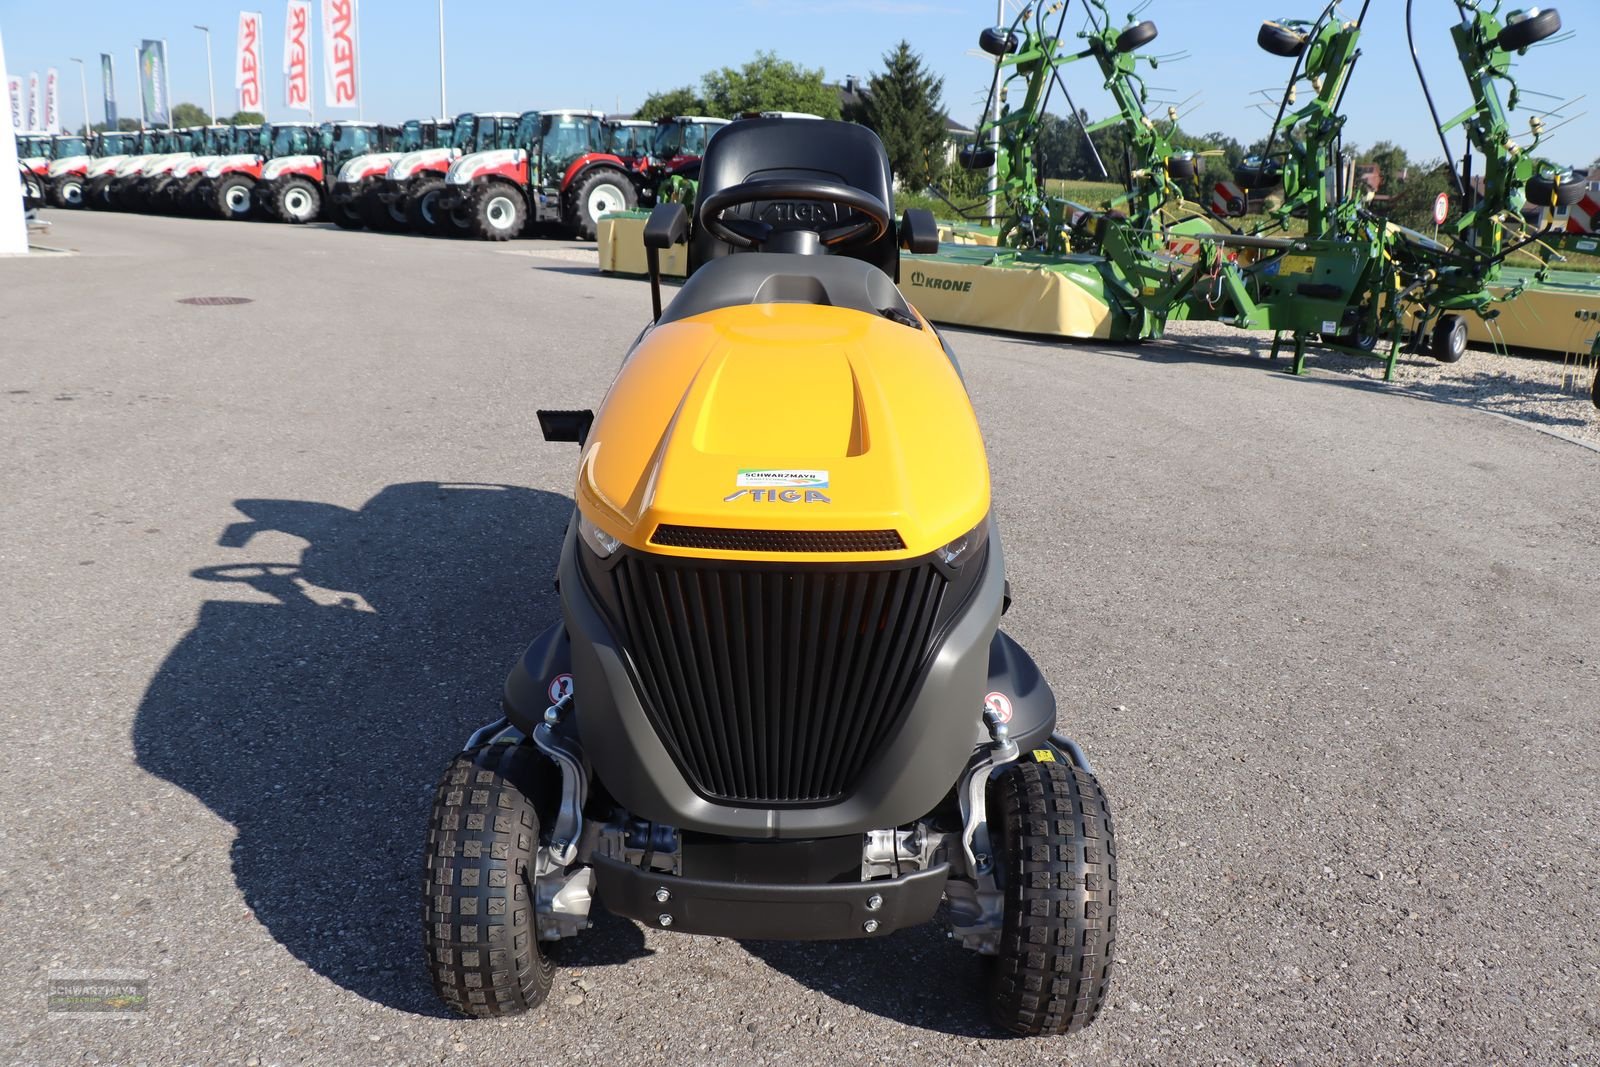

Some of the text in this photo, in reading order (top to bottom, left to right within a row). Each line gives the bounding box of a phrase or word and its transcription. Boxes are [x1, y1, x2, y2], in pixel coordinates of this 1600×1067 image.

[759, 202, 828, 222] STIGA
[925, 277, 972, 292] KRONE
[723, 489, 831, 503] STIGA
